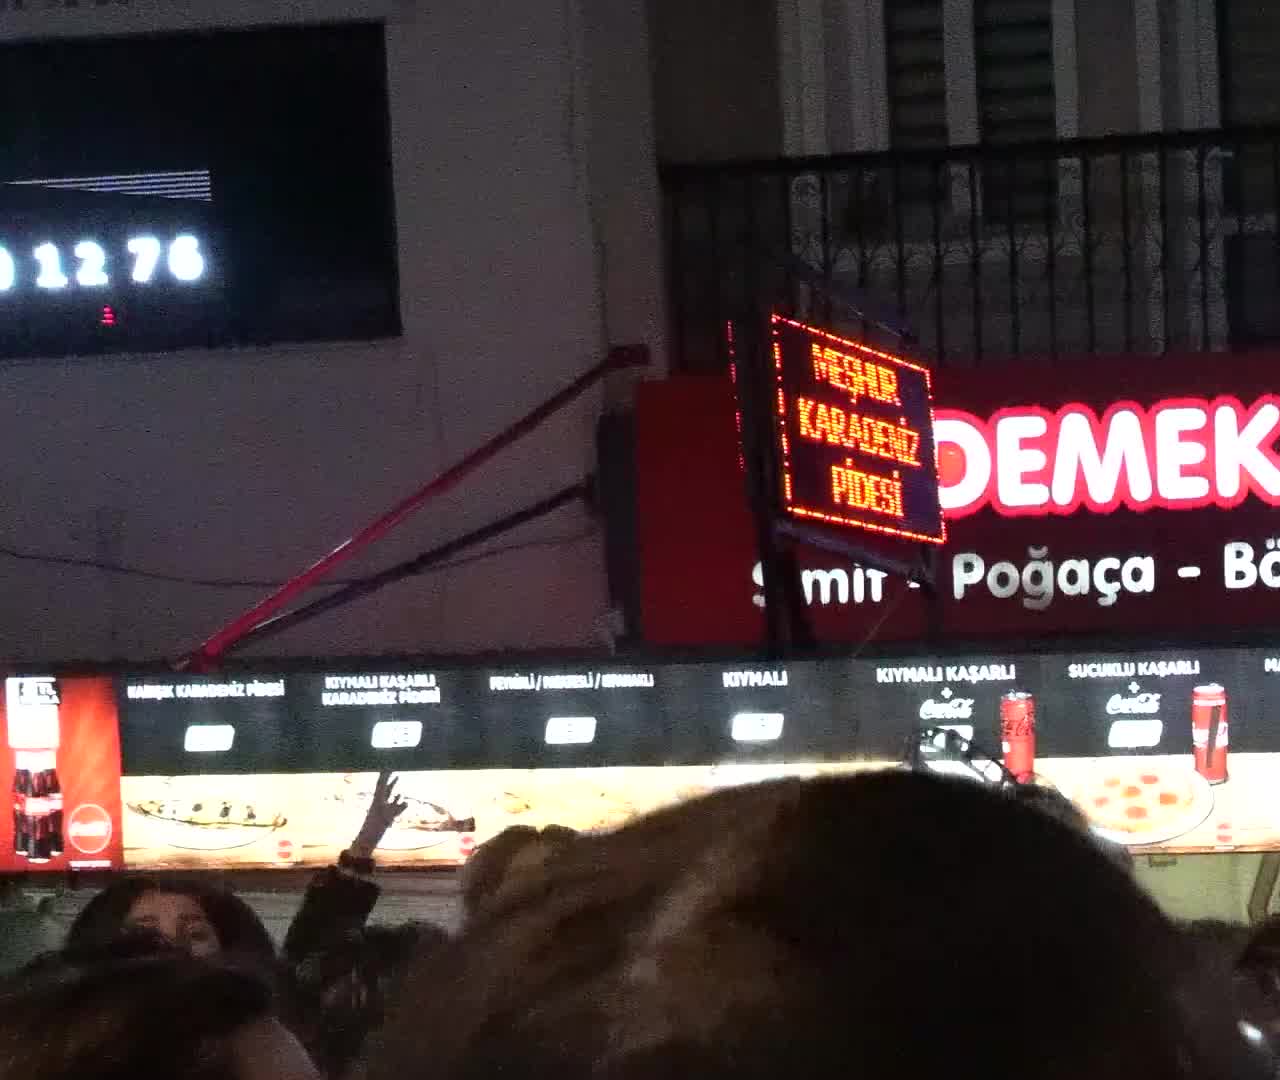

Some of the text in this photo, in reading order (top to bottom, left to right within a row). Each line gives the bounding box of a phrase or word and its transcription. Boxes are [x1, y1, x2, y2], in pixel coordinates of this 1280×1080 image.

[811, 343, 902, 406] MEŞHUR
[797, 397, 921, 467] KARADENİZ
[831, 457, 905, 517] PİDESİ
[752, 560, 889, 607] mit
[952, 545, 1156, 611] Poğaça
[722, 670, 788, 688] KIYMALI
[876, 664, 1016, 684] KIYMALI KAŞARLI
[1068, 660, 1201, 678] SUCUKLU KAŞARLI
